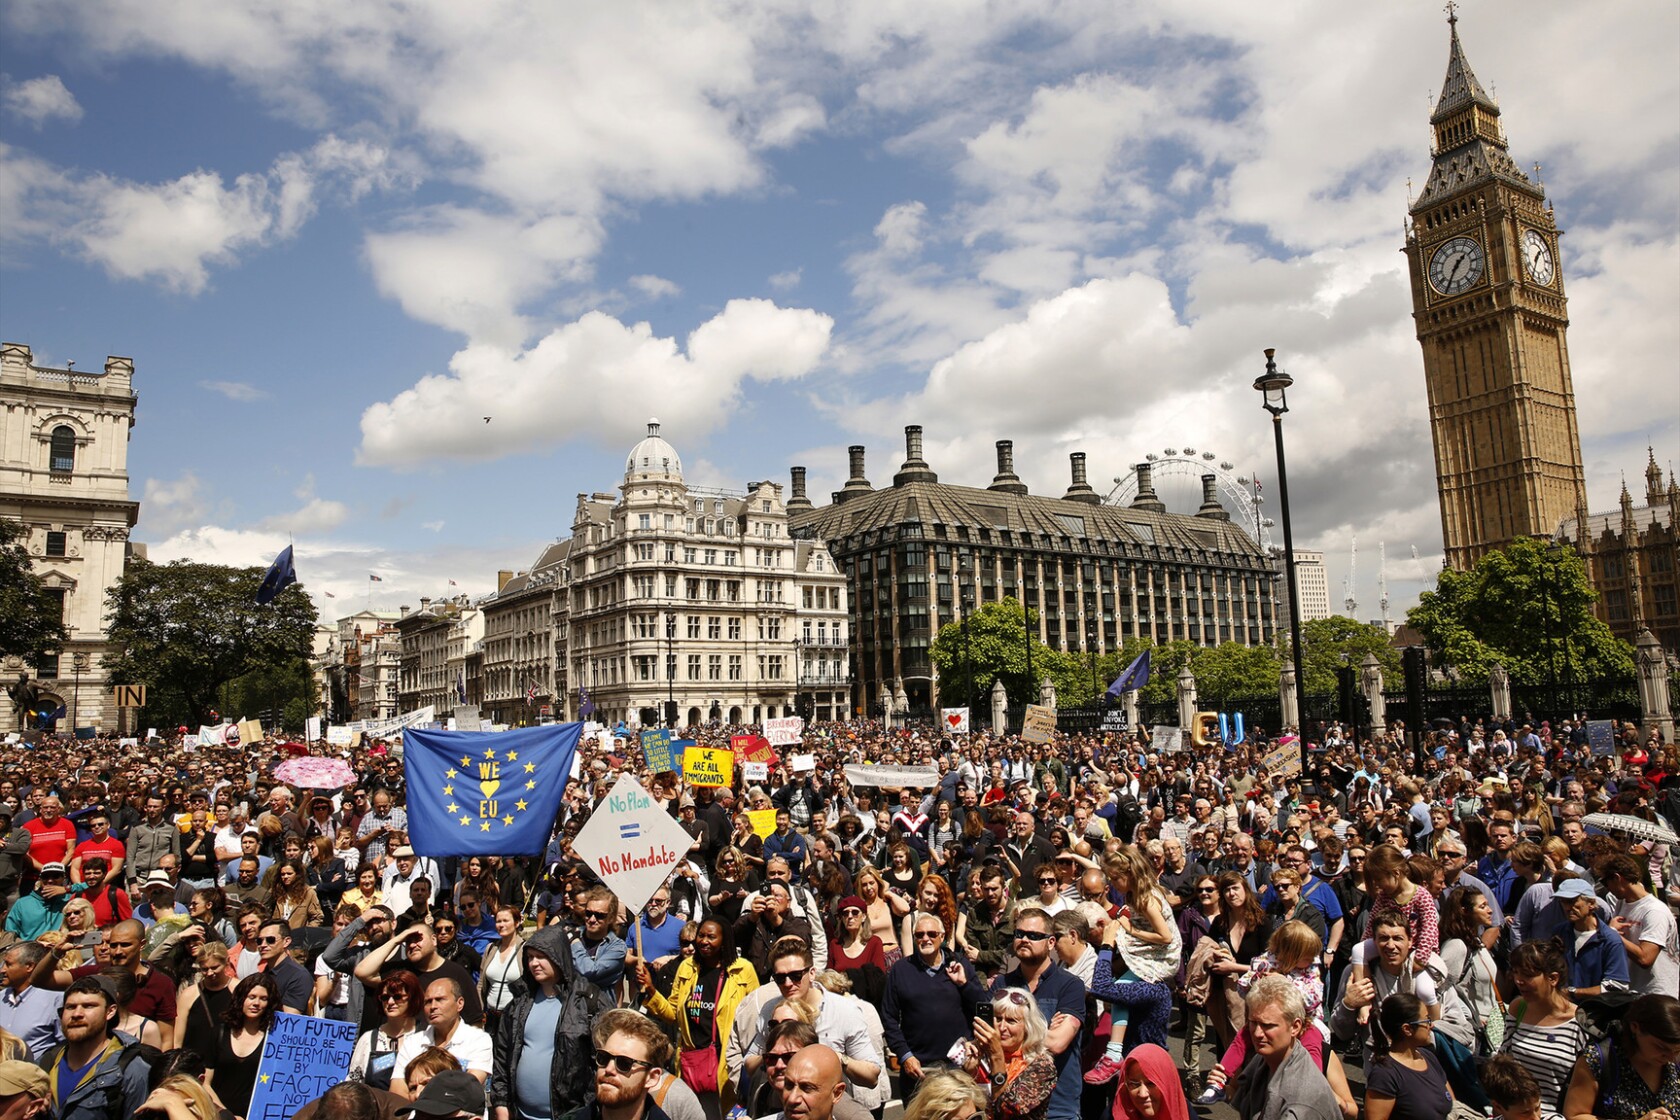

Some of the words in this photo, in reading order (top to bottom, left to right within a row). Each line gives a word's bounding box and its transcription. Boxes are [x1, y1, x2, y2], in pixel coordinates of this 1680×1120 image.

[118, 685, 142, 706] IN
[702, 750, 714, 761] WE
[478, 761, 500, 780] WE
[692, 761, 706, 772] ARE
[707, 763, 719, 773] ALL
[685, 772, 724, 785] IMMIGRANTS
[479, 800, 498, 819] EU
[609, 795, 627, 814] No
[627, 791, 650, 811] Plan
[598, 855, 619, 876] No
[621, 845, 676, 872] Mandate
[692, 992, 702, 1001] IN
[690, 1008, 700, 1017] IN
[273, 1015, 300, 1034] MY
[305, 1020, 357, 1041] FUTURE
[280, 1034, 317, 1047] SHOULD
[322, 1039, 336, 1049] BE
[263, 1042, 351, 1069] DETERMINED
[293, 1062, 309, 1074] BY
[283, 1093, 311, 1106] NOT
